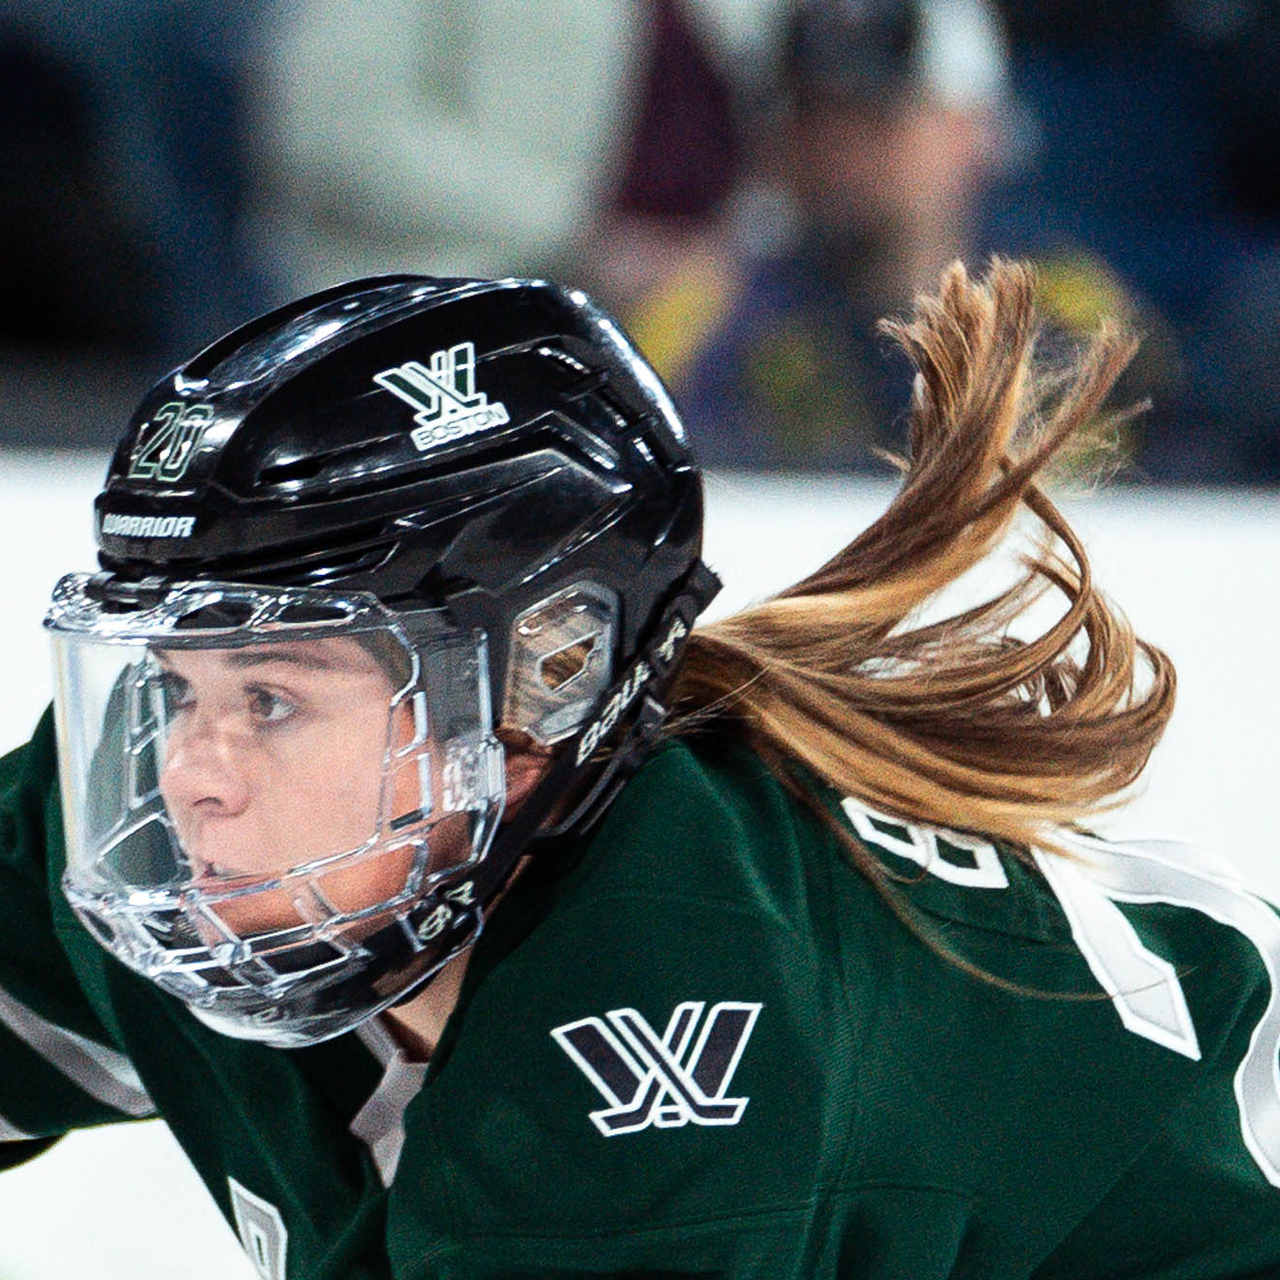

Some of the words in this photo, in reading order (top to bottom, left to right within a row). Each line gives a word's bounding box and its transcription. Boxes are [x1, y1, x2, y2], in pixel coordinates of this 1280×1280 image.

[127, 402, 214, 482] 20
[416, 408, 505, 446] BOSTON
[102, 514, 196, 537] WARRIOR
